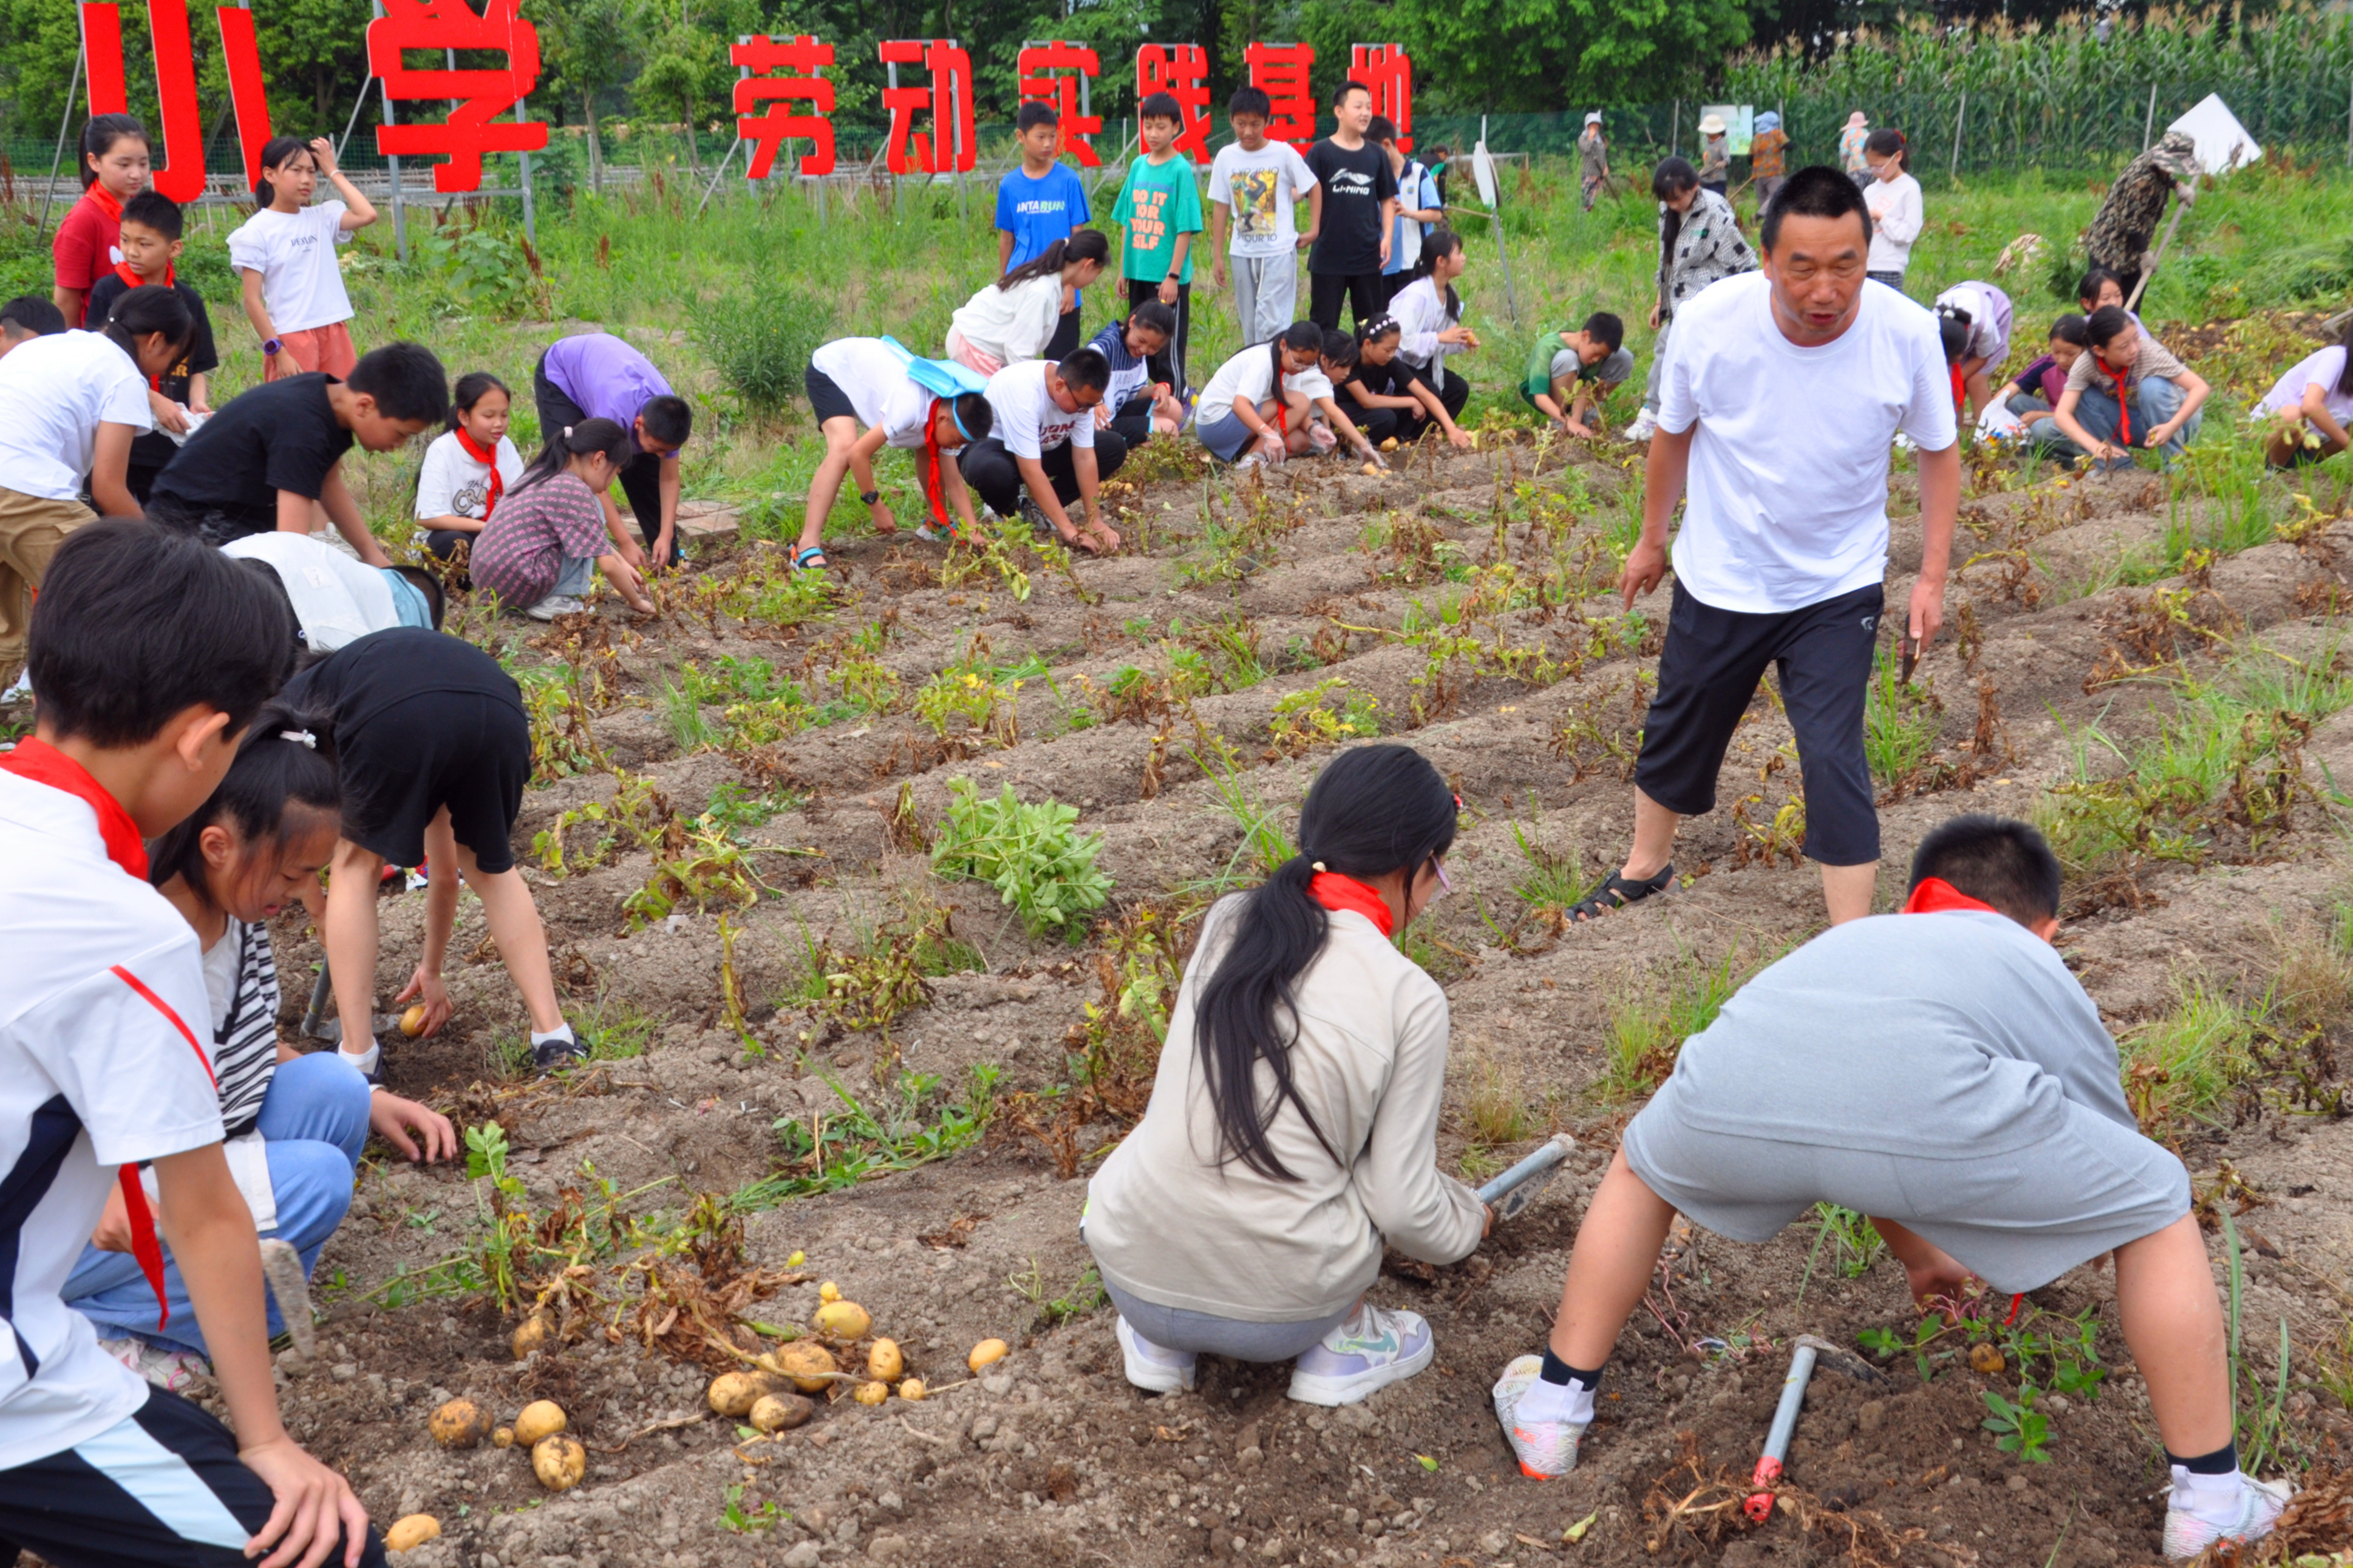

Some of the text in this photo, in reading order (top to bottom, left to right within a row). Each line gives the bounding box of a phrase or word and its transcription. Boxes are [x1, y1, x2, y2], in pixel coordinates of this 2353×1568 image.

[1332, 184, 1370, 195] LI-NING
[1133, 189, 1168, 206] DO IT
[1016, 200, 1066, 213] ANTA RUN
